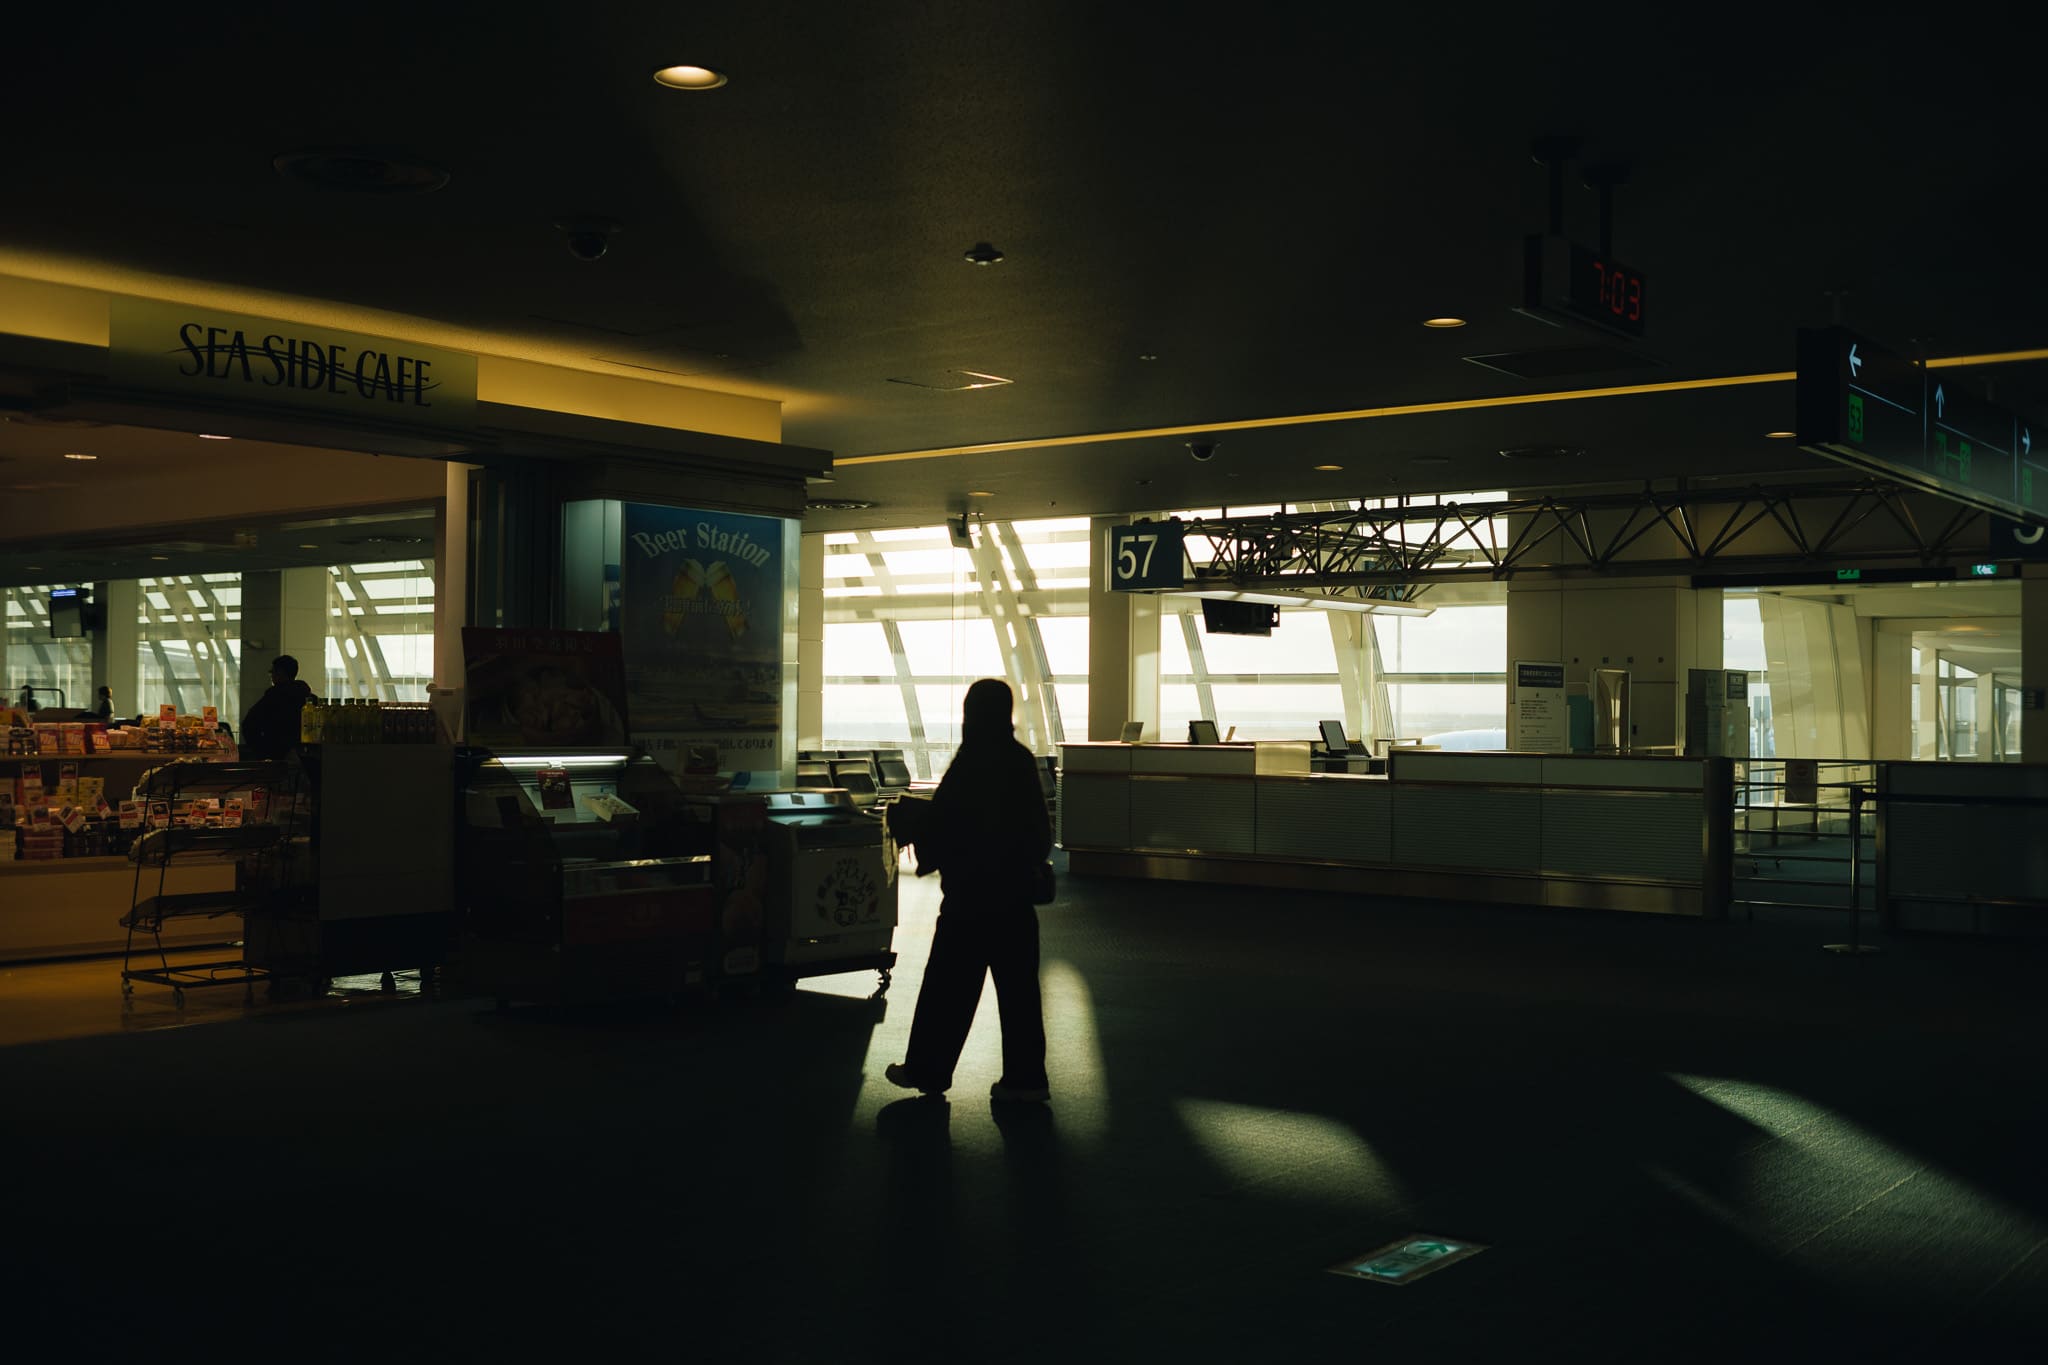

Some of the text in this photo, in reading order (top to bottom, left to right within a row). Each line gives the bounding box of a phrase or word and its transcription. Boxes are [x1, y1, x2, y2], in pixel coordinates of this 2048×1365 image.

[1592, 261, 1641, 321] 7:03
[179, 323, 431, 407] SEA SIDE CAFE
[632, 521, 771, 568] Beer Station
[1117, 534, 1159, 580] 57
